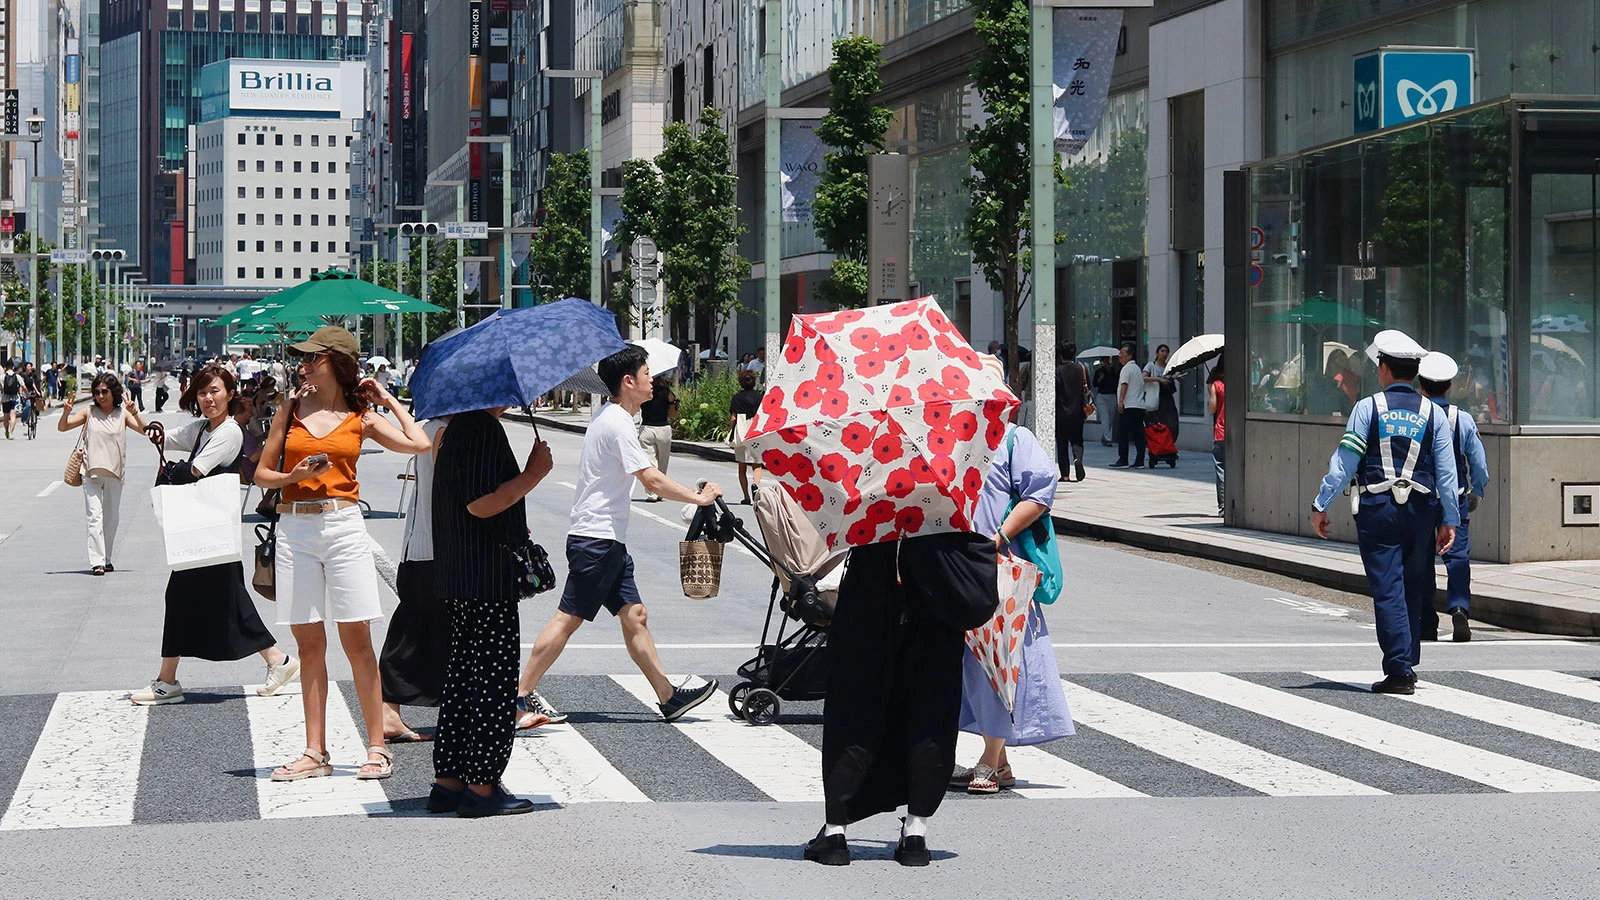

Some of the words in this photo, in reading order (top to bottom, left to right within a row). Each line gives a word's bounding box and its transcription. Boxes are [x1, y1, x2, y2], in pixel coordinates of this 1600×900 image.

[240, 71, 333, 91] Brillia
[1070, 57, 1091, 96] 和光
[785, 162, 818, 172] WAKO
[448, 226, 486, 234] 銀座二丁目
[1381, 411, 1426, 428] POLICE
[1386, 424, 1419, 437] 警視庁
